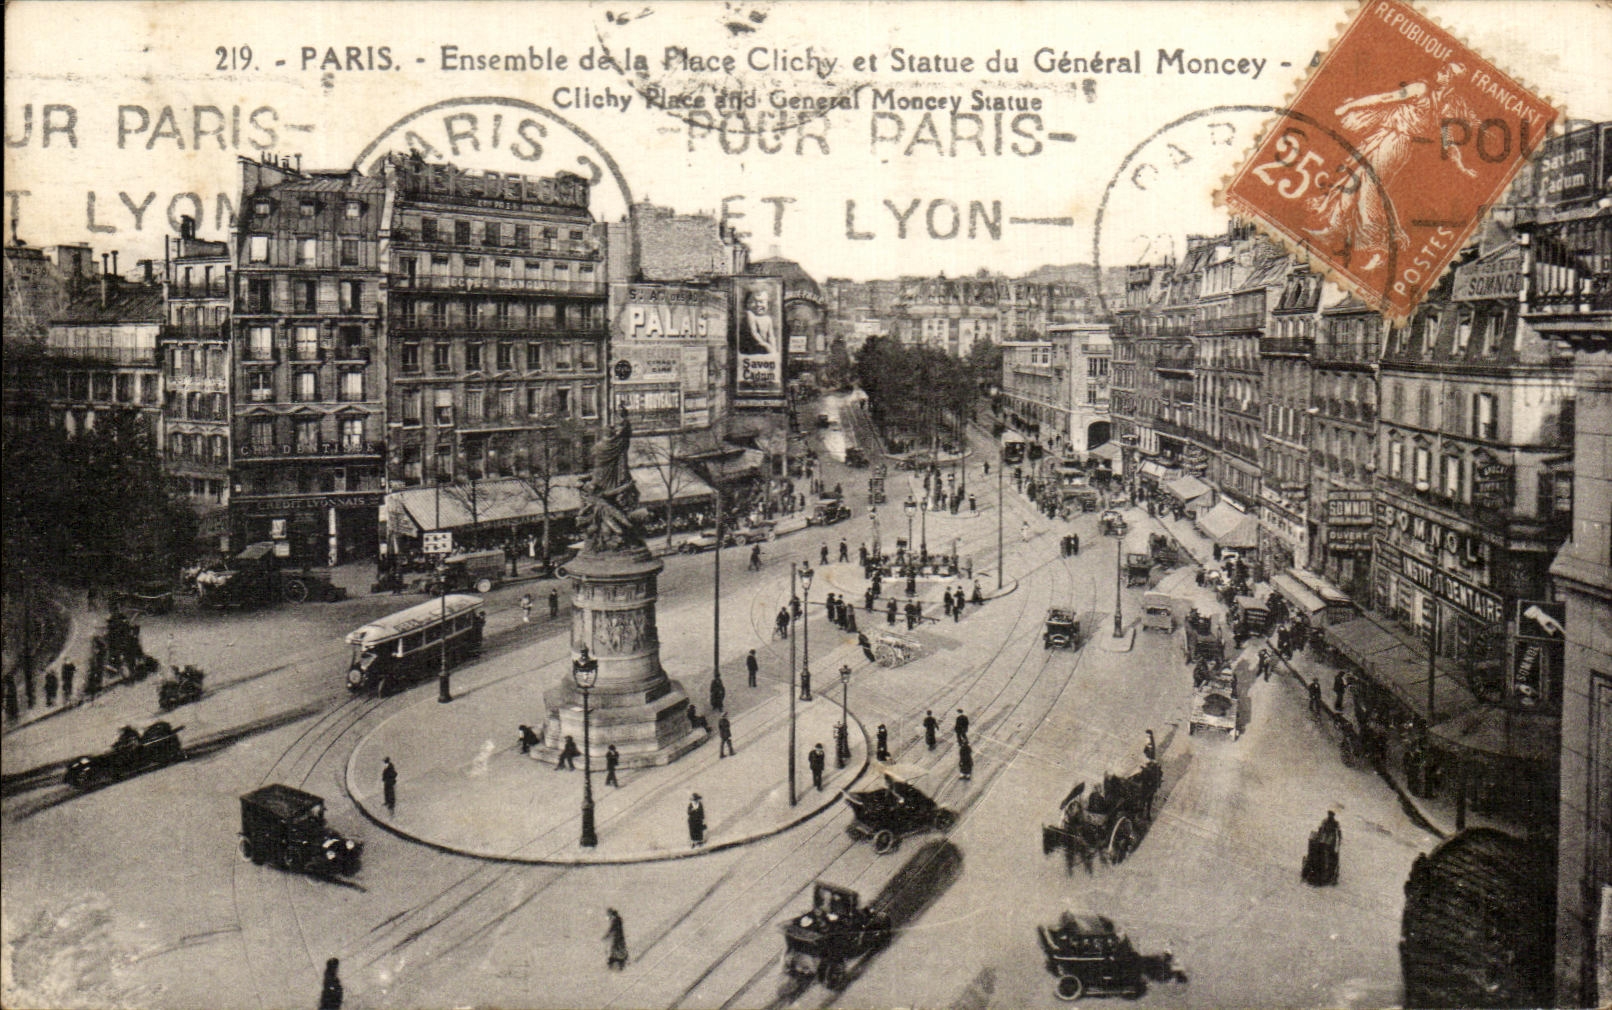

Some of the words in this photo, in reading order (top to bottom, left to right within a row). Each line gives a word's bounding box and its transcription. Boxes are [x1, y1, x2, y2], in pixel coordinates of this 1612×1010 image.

[1393, 226, 1454, 296] POSTES
[742, 358, 776, 370] Savon
[742, 368, 776, 381] Cadum
[1383, 505, 1478, 563] SOMNOL
